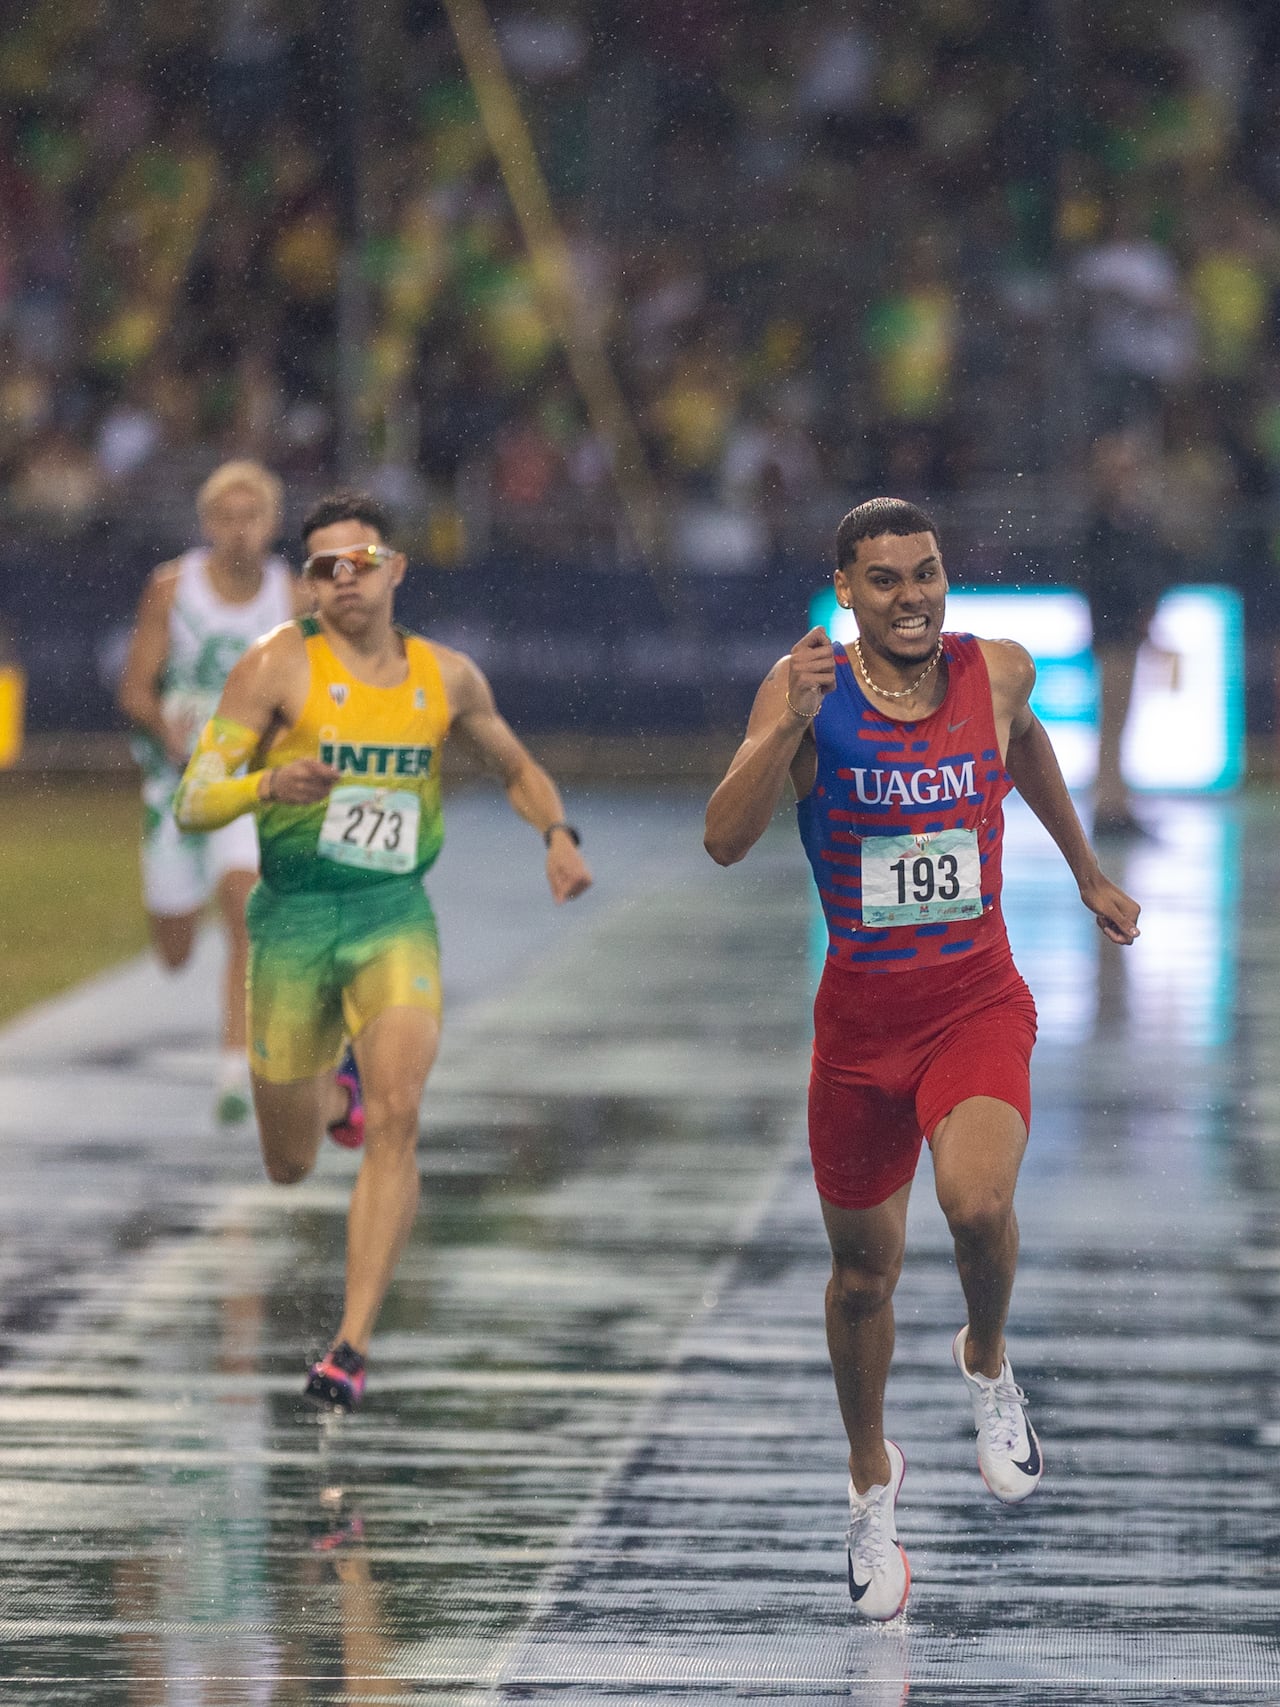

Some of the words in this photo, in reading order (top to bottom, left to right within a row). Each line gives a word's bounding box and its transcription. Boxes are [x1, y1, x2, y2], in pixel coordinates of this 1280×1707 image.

[320, 742, 433, 776] INTER
[851, 761, 977, 805] UAGM
[341, 805, 404, 852] 273
[890, 854, 960, 904] 193
